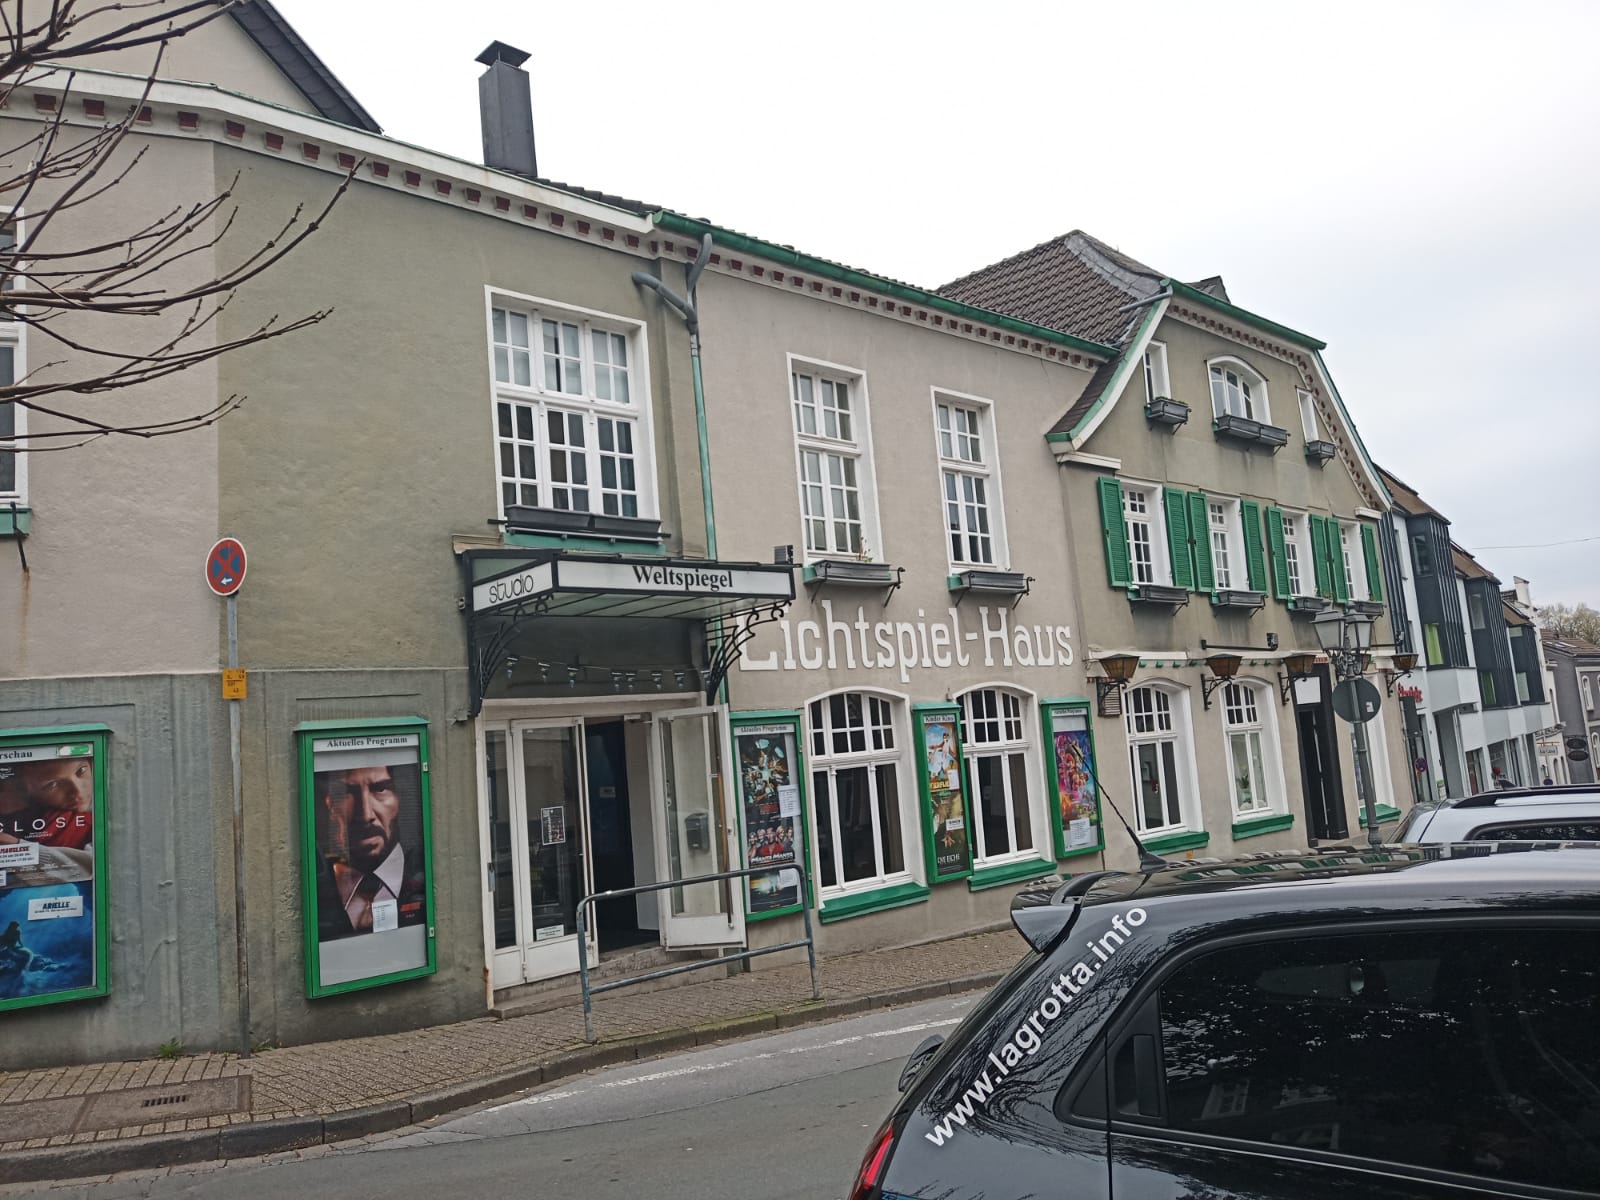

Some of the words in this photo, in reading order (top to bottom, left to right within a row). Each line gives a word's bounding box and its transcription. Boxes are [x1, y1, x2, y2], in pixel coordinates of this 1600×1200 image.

[489, 573, 534, 604] studio
[632, 565, 733, 592] Weltspiegel
[737, 599, 1074, 684] Lichtspiel-Haus
[327, 738, 365, 748] Aktuelles
[366, 736, 408, 746] Programm
[925, 907, 1147, 1147] www.lagrotta.info
